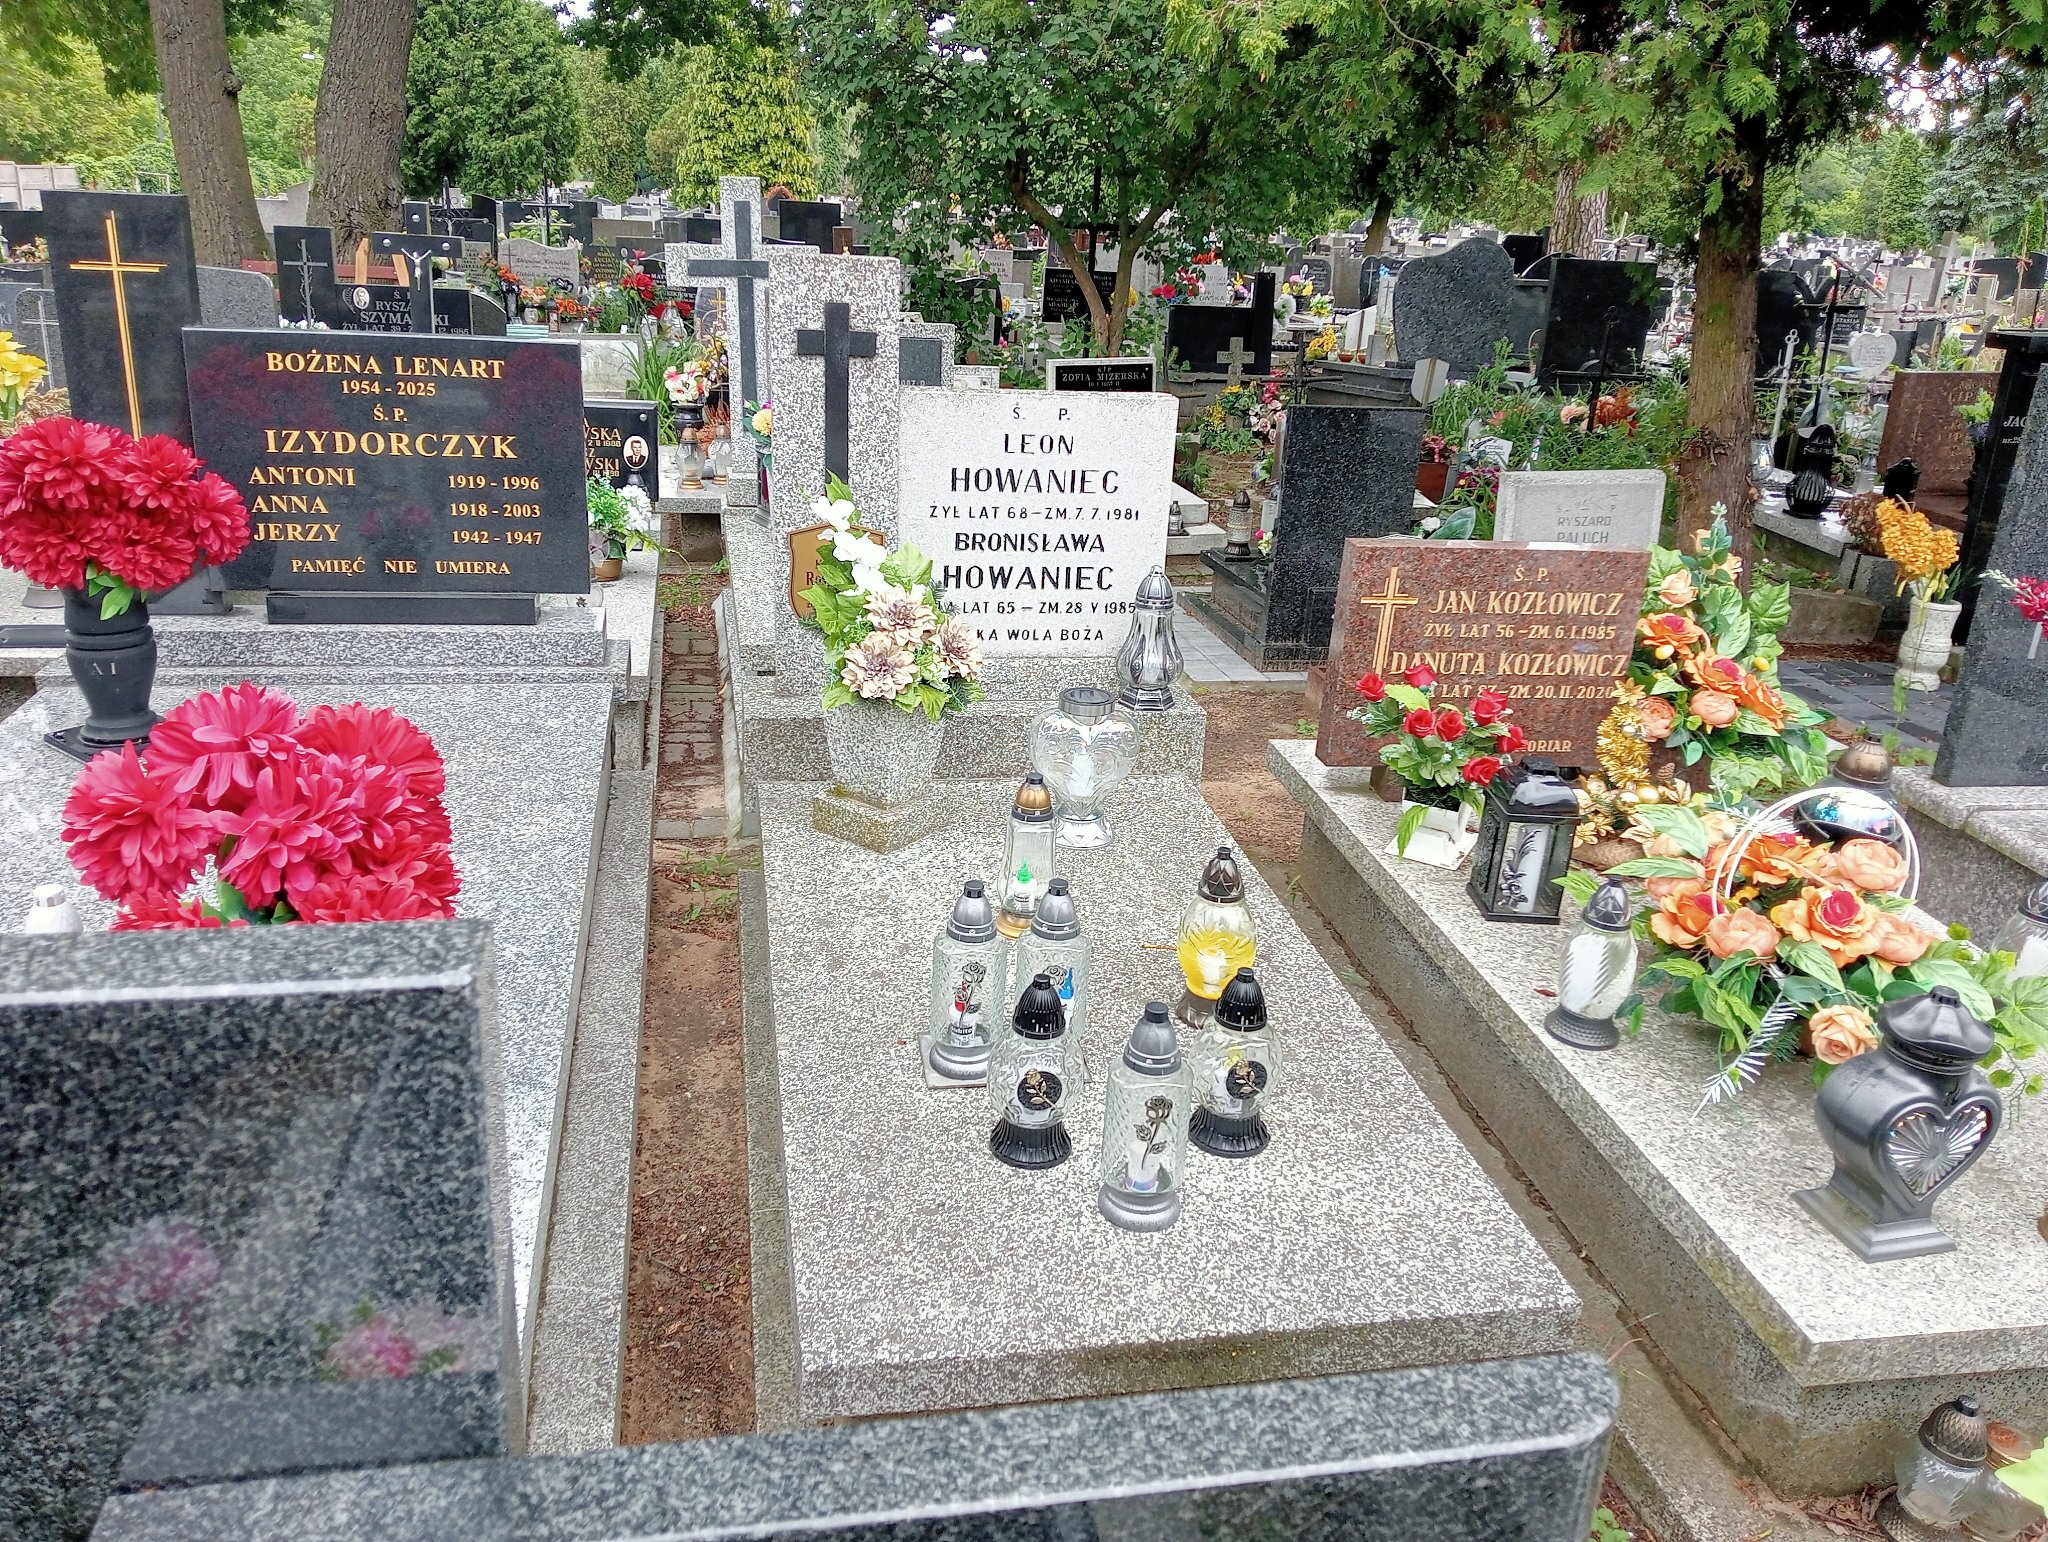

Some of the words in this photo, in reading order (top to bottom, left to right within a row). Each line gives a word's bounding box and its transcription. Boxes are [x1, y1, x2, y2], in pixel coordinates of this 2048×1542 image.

[375, 300, 412, 312] RYSZA
[266, 348, 382, 375] BOŻENA
[394, 356, 505, 380] LENART
[1062, 373, 1091, 382] ZOFIA
[1096, 372, 1147, 380] MIZERSKA
[341, 379, 380, 394] 1954
[396, 382, 436, 396] 2025
[264, 429, 518, 459] IZYDORCZYK
[1004, 434, 1074, 454] LEON
[248, 466, 356, 486] ANTONI
[448, 475, 486, 490] 1919
[502, 476, 540, 490] 1996
[950, 467, 1119, 494] HOWANIEC
[250, 494, 328, 514] ANNA
[450, 502, 488, 516] 1918
[503, 504, 540, 518] 2003
[930, 501, 961, 519] ŻYŁ
[968, 506, 1001, 520] LAT
[1557, 516, 1612, 526] RYSZARD
[253, 522, 342, 542] JERZY
[452, 530, 489, 544] 1942
[505, 531, 542, 545] 1947
[954, 532, 1105, 552] BRONISŁAWA
[290, 556, 366, 576] PAMIĘĆ
[384, 560, 418, 574] NIE
[434, 560, 511, 575] UMIERA
[943, 565, 1114, 590] HOWANIEC
[962, 602, 990, 614] LAT
[997, 602, 1016, 614] 65
[1104, 602, 1136, 614] 1985
[1428, 590, 1478, 614] JAN
[1486, 590, 1625, 616] KOZŁOWICZ
[976, 629, 998, 641] KA
[1007, 629, 1052, 641] WOLA
[1060, 625, 1104, 641] BOŻA
[1423, 620, 1454, 637] ŻYŁ
[1460, 624, 1491, 638] LAT
[1496, 624, 1514, 638] 56
[1389, 652, 1486, 676] DANUTA
[1496, 654, 1629, 677] KOZŁOWICZ
[1440, 684, 1473, 698] LAT
[1517, 740, 1572, 752] ORIAR
